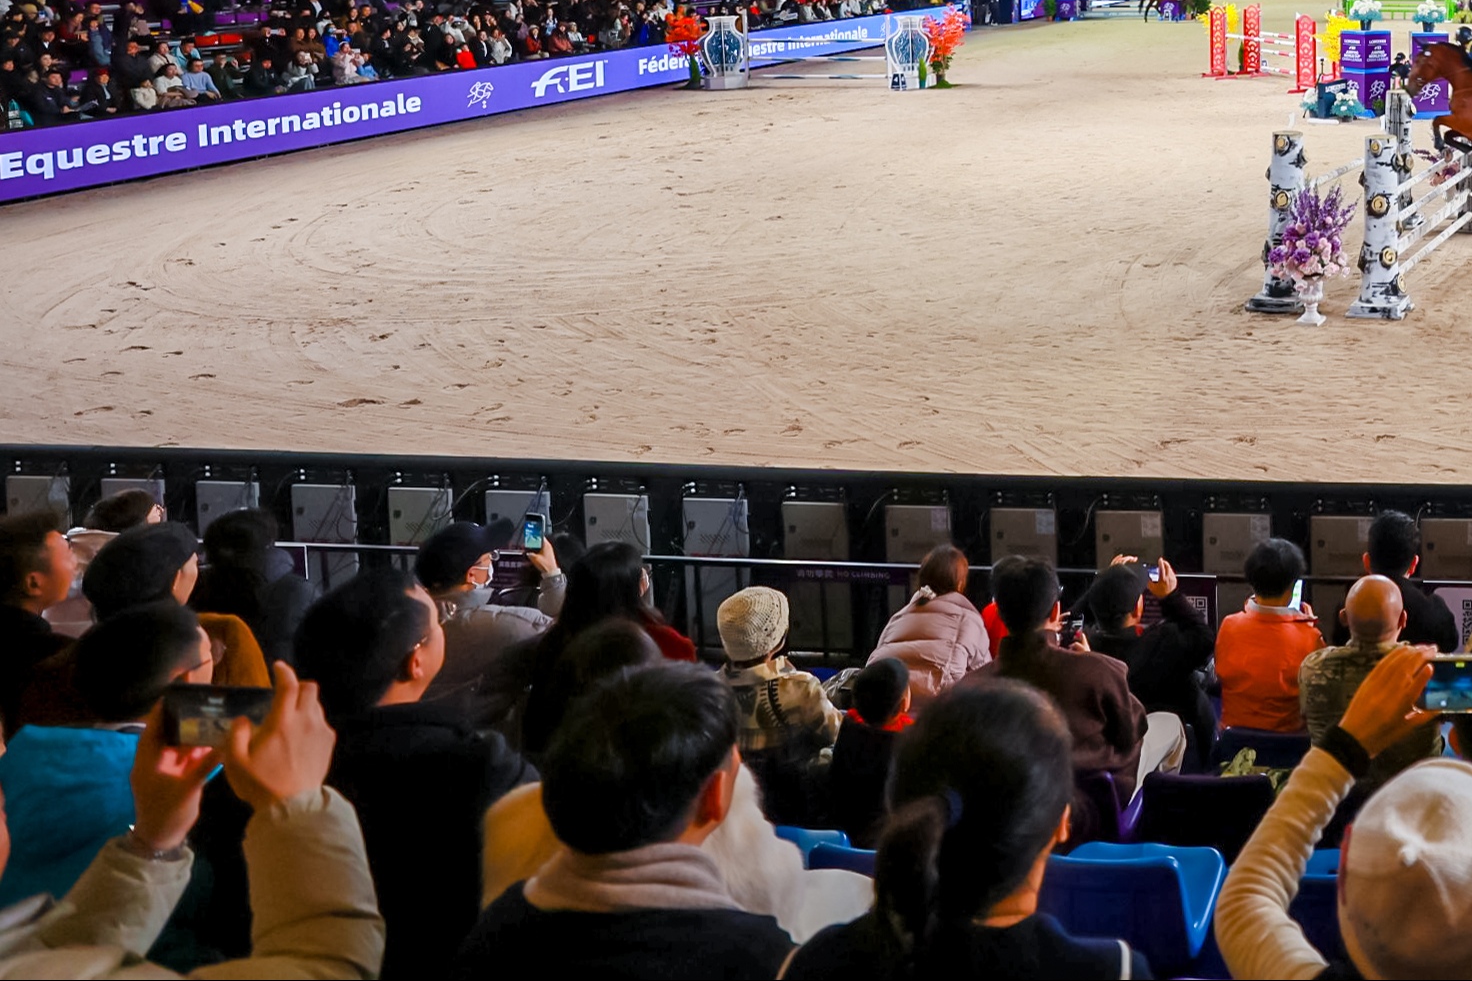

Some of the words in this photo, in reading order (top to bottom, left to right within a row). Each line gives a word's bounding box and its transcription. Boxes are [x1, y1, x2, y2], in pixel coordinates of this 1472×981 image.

[530, 60, 605, 97] FEI
[0, 130, 188, 180] Equestre
[198, 92, 422, 149] Internationale
